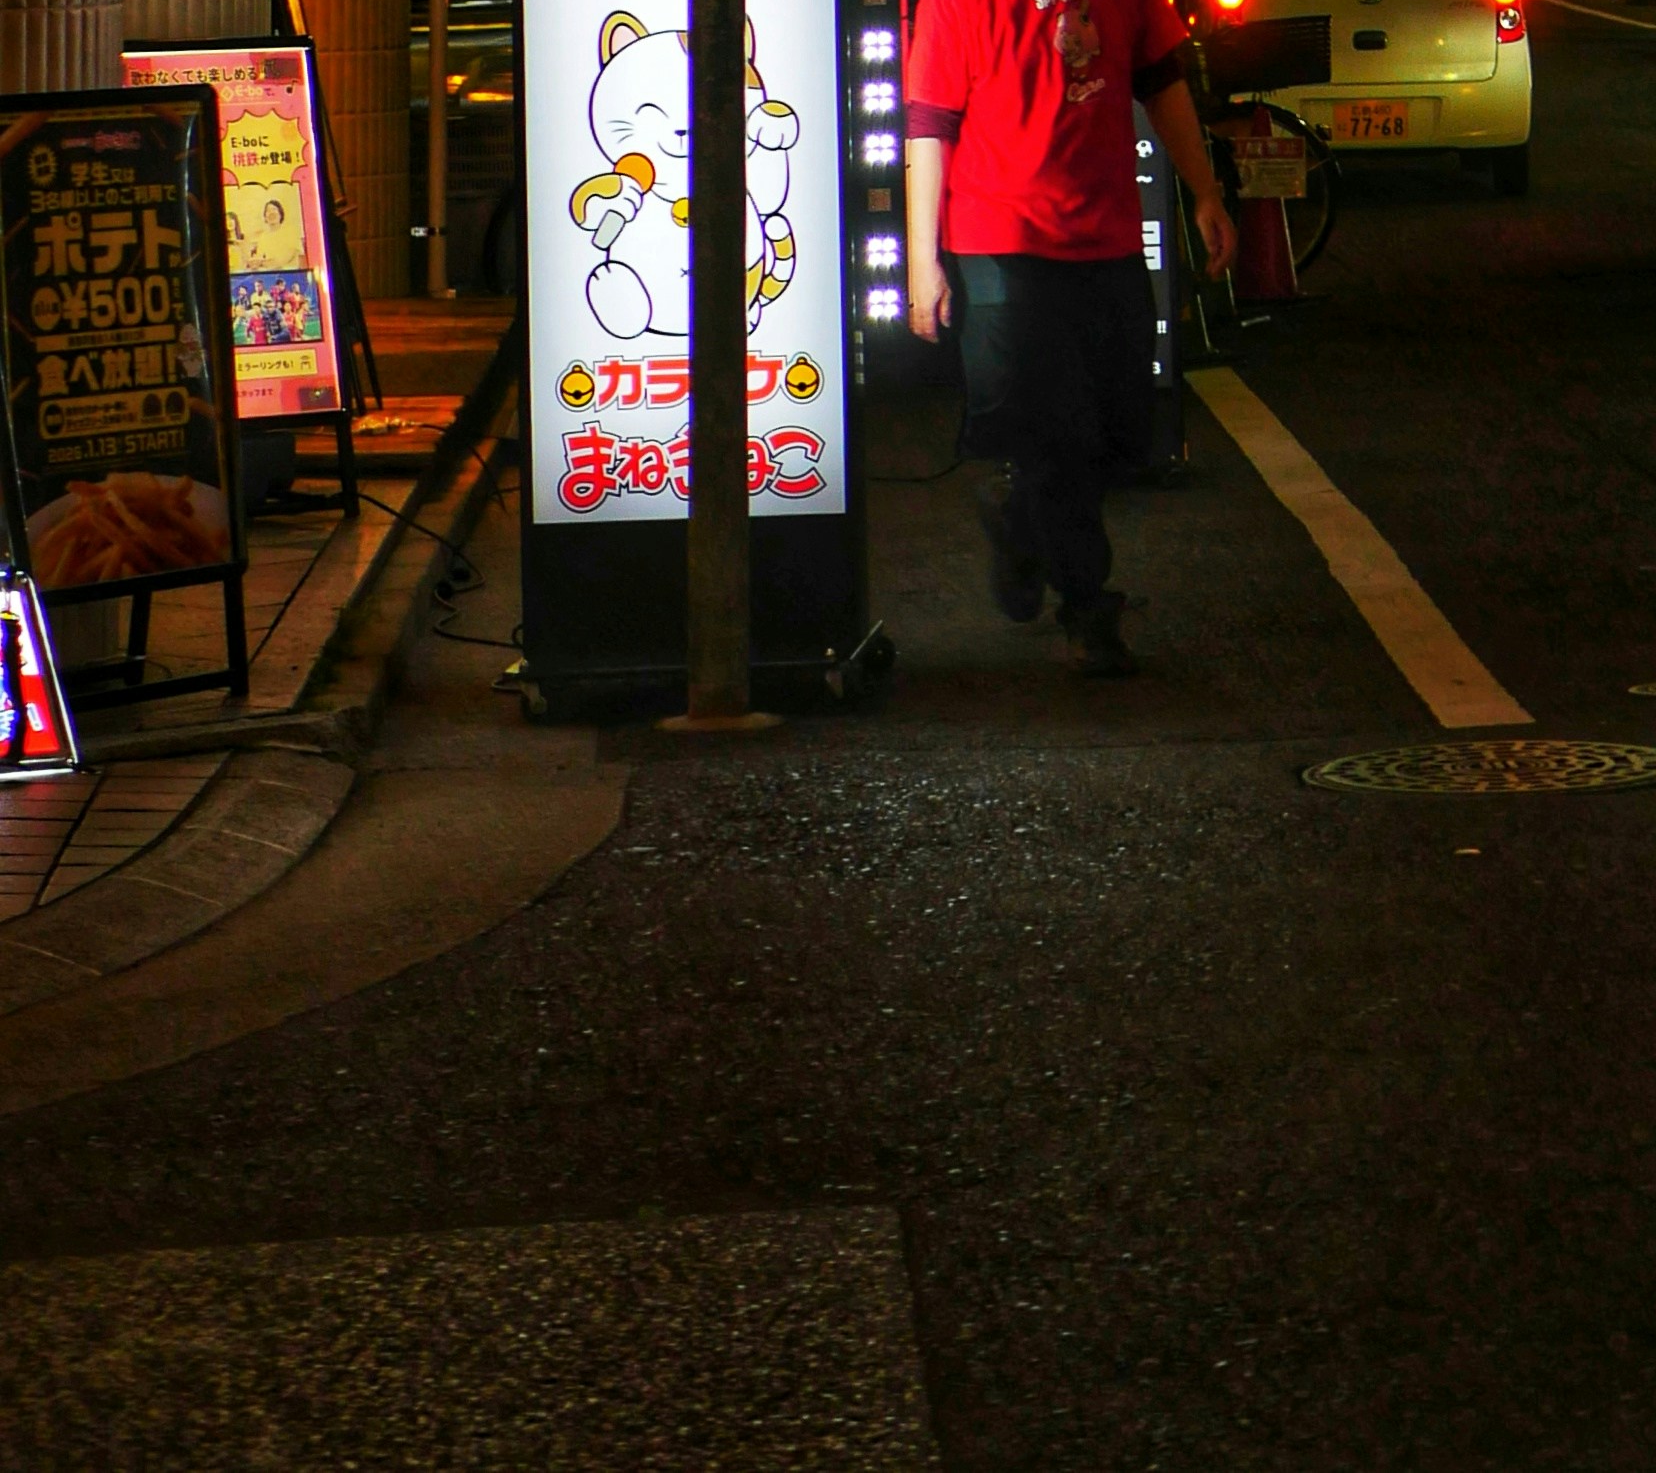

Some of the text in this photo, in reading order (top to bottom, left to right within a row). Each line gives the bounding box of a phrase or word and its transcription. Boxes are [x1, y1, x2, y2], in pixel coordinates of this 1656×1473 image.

[33, 207, 183, 278] ポテト
[58, 273, 171, 331] ¥500
[36, 343, 179, 397] 食べ放題!
[596, 356, 785, 411] カラケ
